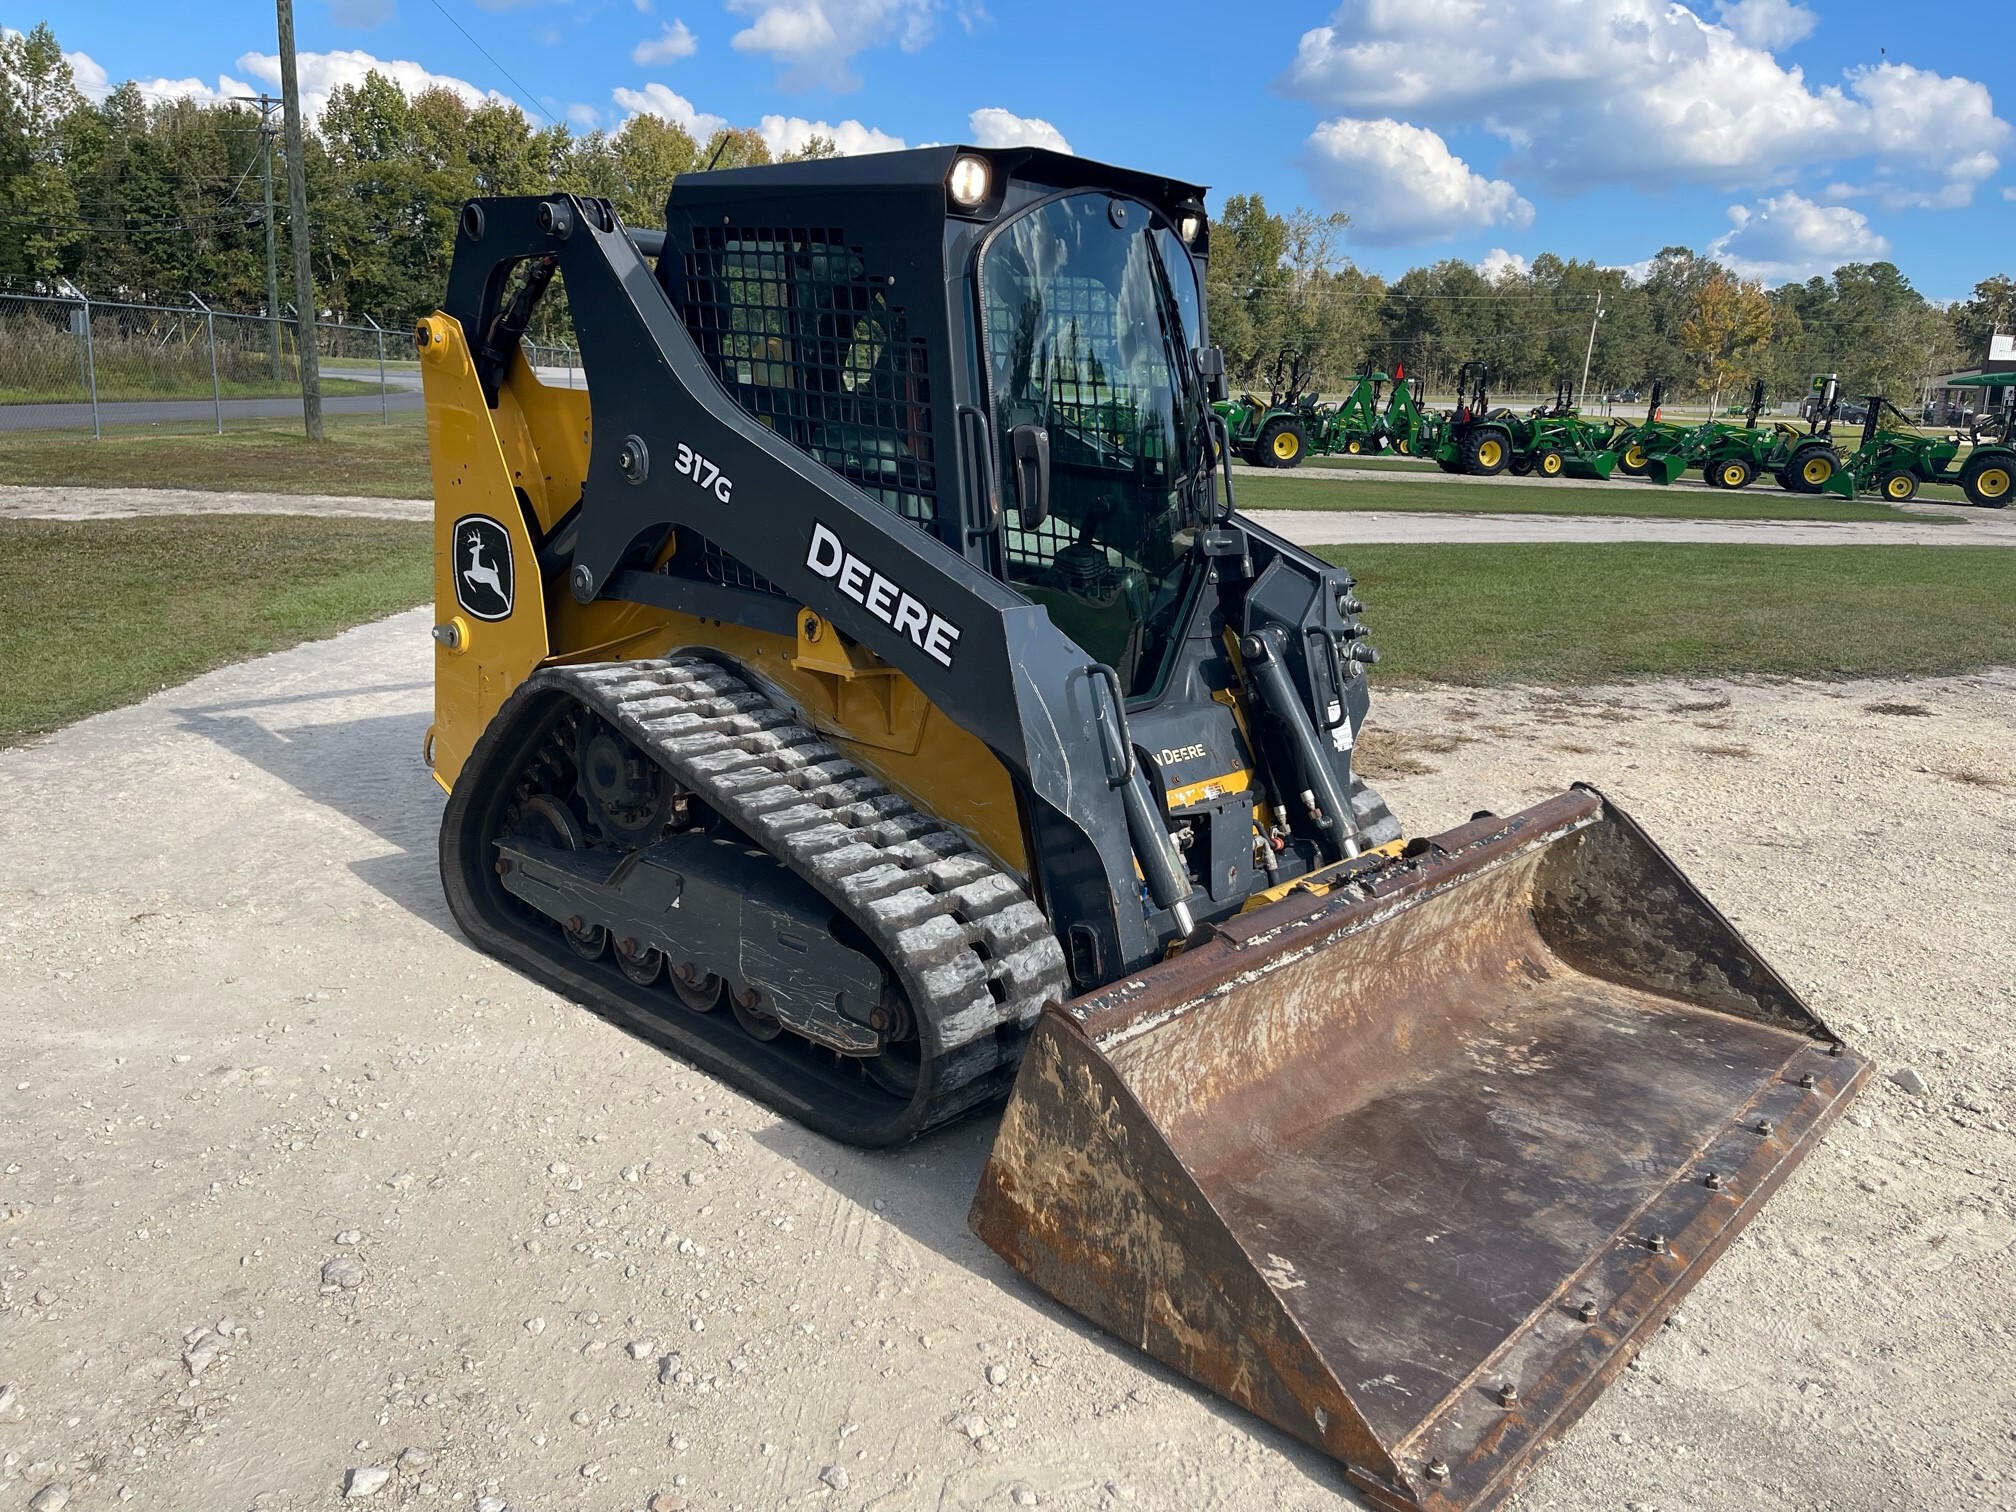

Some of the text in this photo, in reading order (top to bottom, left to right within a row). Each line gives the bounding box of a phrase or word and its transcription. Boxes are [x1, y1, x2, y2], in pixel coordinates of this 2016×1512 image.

[674, 442, 733, 504] 317G
[806, 522, 961, 668] DEERE
[1161, 743, 1207, 765] DEERE
